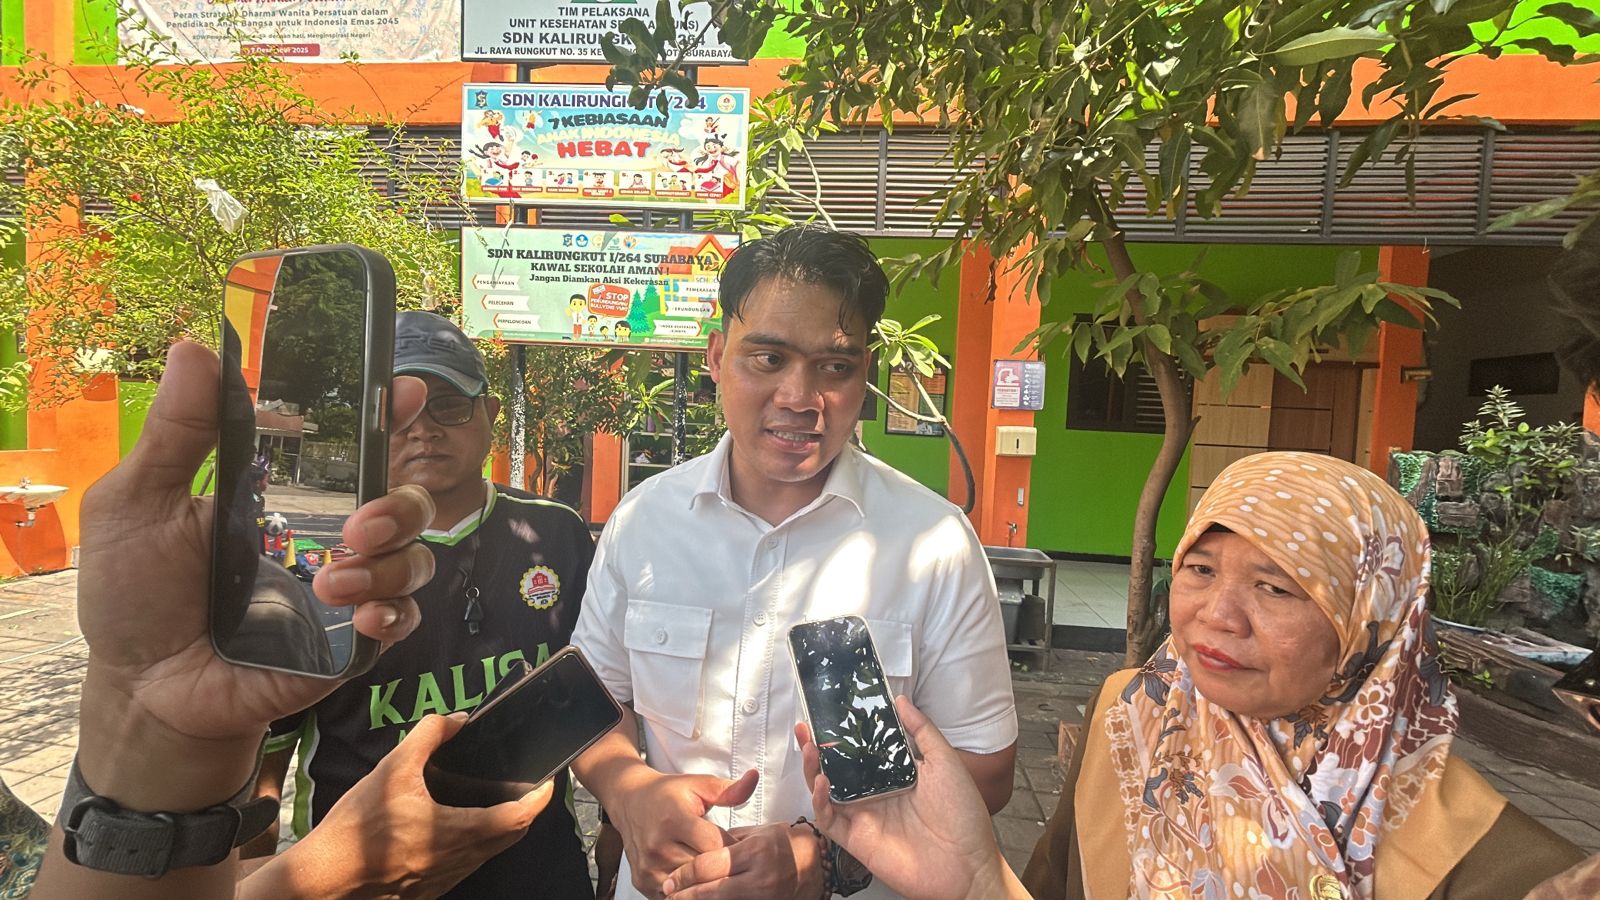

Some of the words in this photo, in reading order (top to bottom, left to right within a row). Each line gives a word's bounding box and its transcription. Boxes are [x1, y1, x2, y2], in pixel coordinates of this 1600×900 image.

[173, 11, 199, 19] Peran
[241, 9, 275, 17] Dharma
[279, 9, 310, 17] Wanita
[361, 8, 388, 16] dalam
[558, 7, 578, 16] TIM
[581, 7, 650, 17] PELAKSANA
[166, 20, 214, 28] Pendidikan
[241, 19, 273, 29] Bangsa
[275, 19, 302, 28] untuk
[304, 18, 348, 26] Indonesia
[509, 19, 536, 28] UNIT
[539, 20, 607, 29] KESEHATAN
[502, 32, 534, 44] SDN
[475, 47, 488, 55] JL.
[489, 47, 512, 55] RAYA
[514, 48, 558, 56] RUNGKUT
[560, 48, 575, 56] NO.
[502, 93, 534, 107] SDN
[547, 117, 560, 130] 7
[561, 113, 669, 129] KEBIASAAN
[581, 127, 681, 145] INDONESIA
[556, 140, 652, 158] HEBAT
[487, 248, 513, 259] SDN
[516, 250, 607, 262] KALIRUNGKUT
[610, 253, 641, 264] I/264
[646, 254, 713, 267] SURABAYA
[530, 263, 571, 273] KAWAL
[573, 264, 626, 274] SEKOLAH
[627, 266, 663, 276] AMAN
[529, 274, 560, 283] Jangan
[562, 275, 600, 284] Diamkan
[623, 277, 669, 286] Kekerasan
[605, 292, 629, 301] STOP
